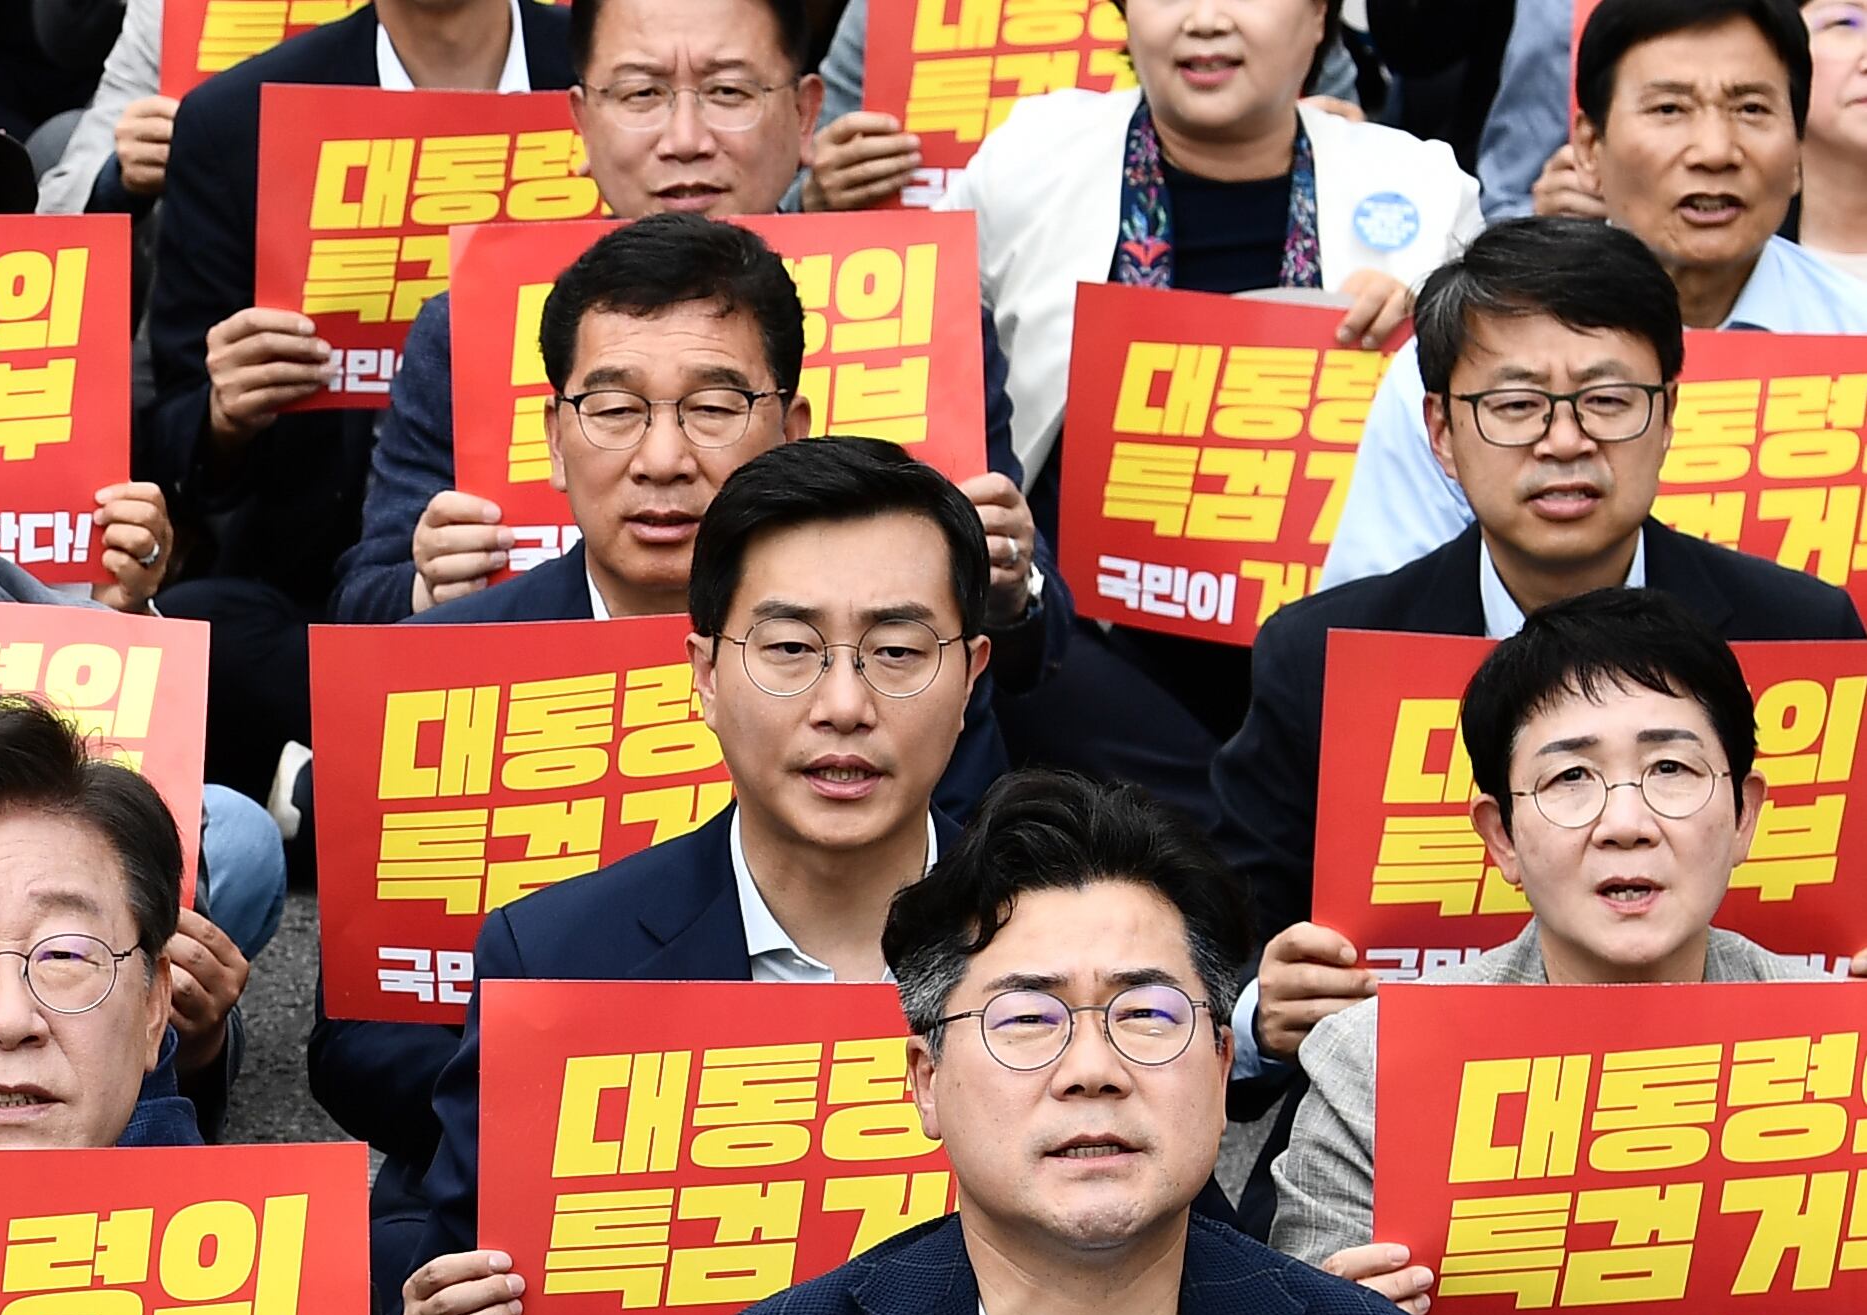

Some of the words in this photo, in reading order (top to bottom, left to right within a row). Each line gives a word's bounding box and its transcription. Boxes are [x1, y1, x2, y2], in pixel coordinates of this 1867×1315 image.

[309, 129, 612, 230] 대통령
[1658, 372, 1867, 485] 통령
[1102, 442, 1296, 543] 특검
[1097, 555, 1236, 625] 국민이
[1448, 1032, 1867, 1184] 대통령
[1437, 1181, 1704, 1310] 특검
